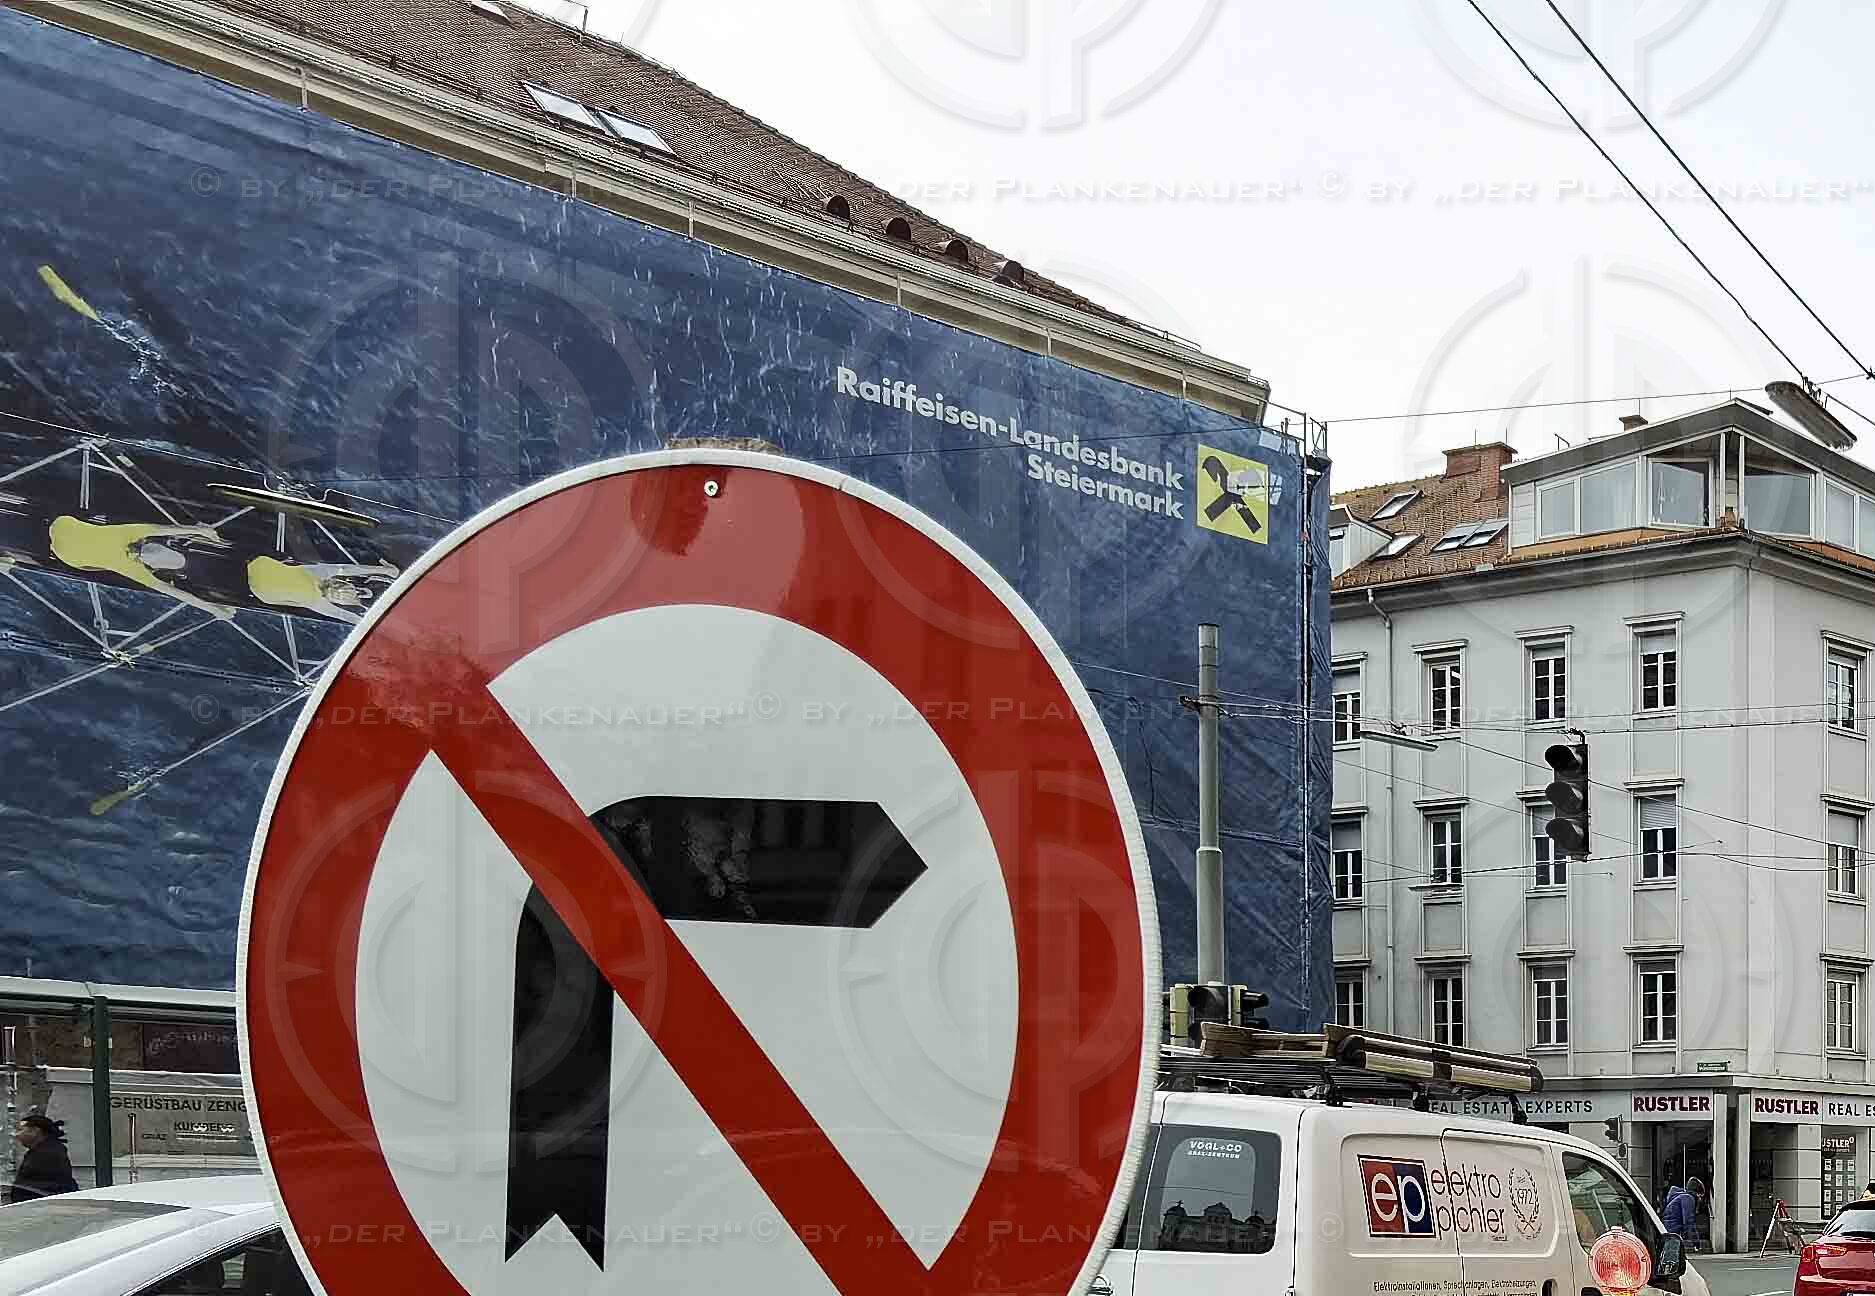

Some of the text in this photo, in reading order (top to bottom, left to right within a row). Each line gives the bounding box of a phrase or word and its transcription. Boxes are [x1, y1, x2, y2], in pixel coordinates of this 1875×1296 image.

[836, 365, 1185, 491] Raiffeisen-Landesbank
[1027, 454, 1185, 520] Steiermark
[1429, 1100, 1593, 1115] EAL ESTAT EXPERTS
[1633, 1096, 1711, 1112] RUSTLER
[1754, 1097, 1819, 1116] RUSTLER
[1828, 1102, 1860, 1117] REAL
[1430, 1163, 1502, 1199] elektro
